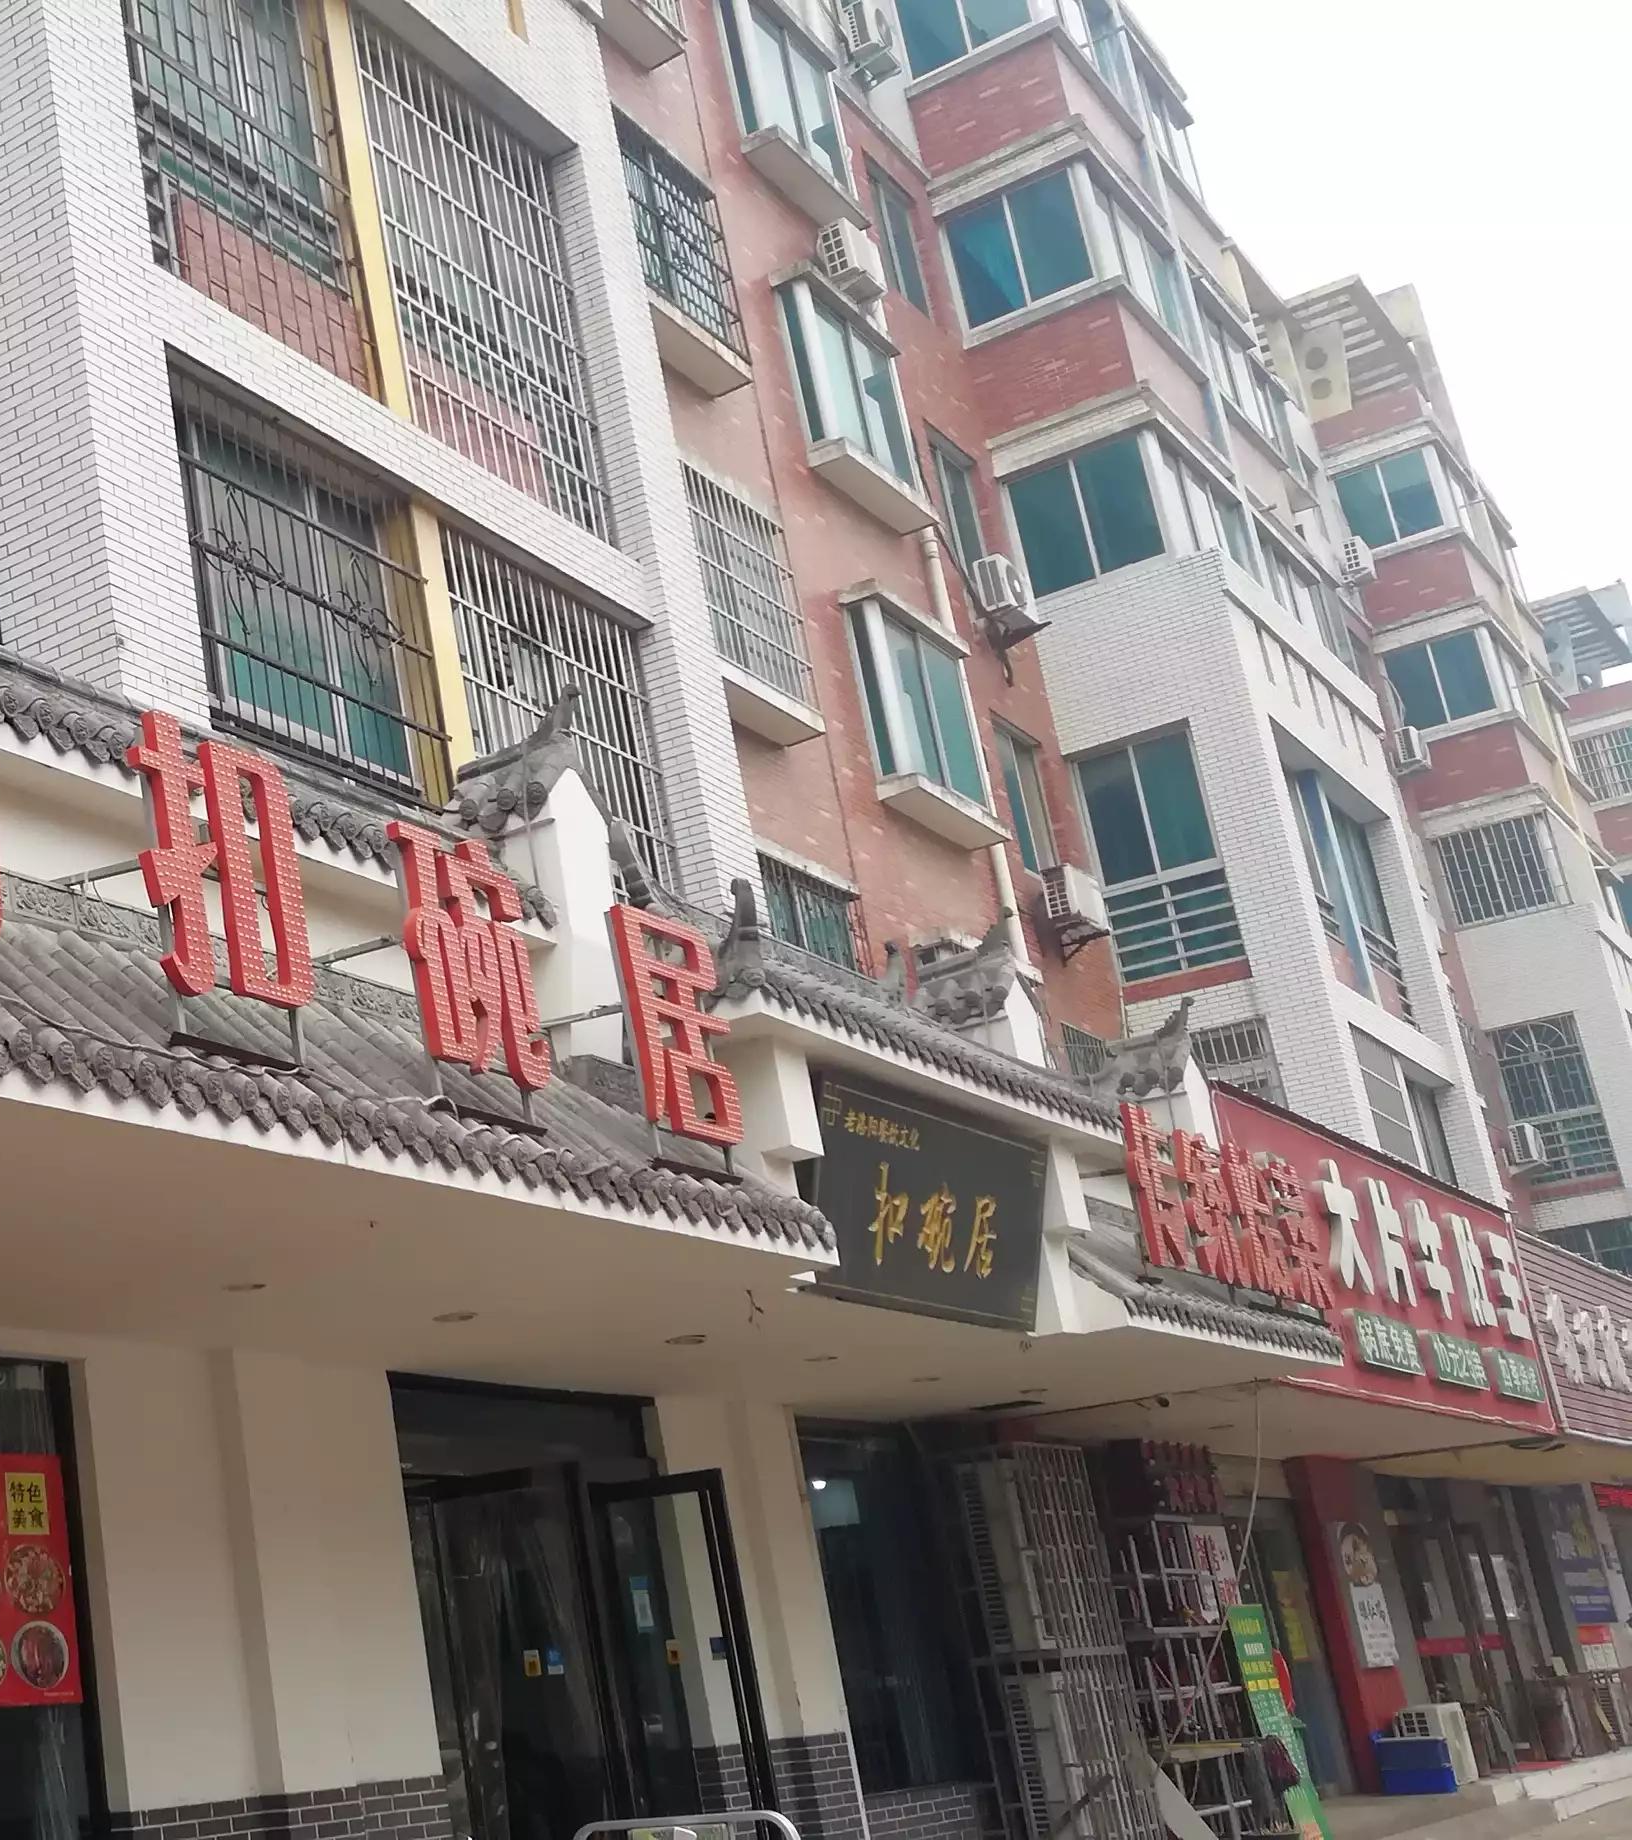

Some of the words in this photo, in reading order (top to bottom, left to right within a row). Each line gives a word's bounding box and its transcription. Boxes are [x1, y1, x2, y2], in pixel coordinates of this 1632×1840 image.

[868, 1160, 997, 1280] 扣碗居
[1313, 1158, 1531, 1341] 大片牛肚王
[9, 1481, 43, 1503] 特色
[12, 1507, 44, 1528] 美食
